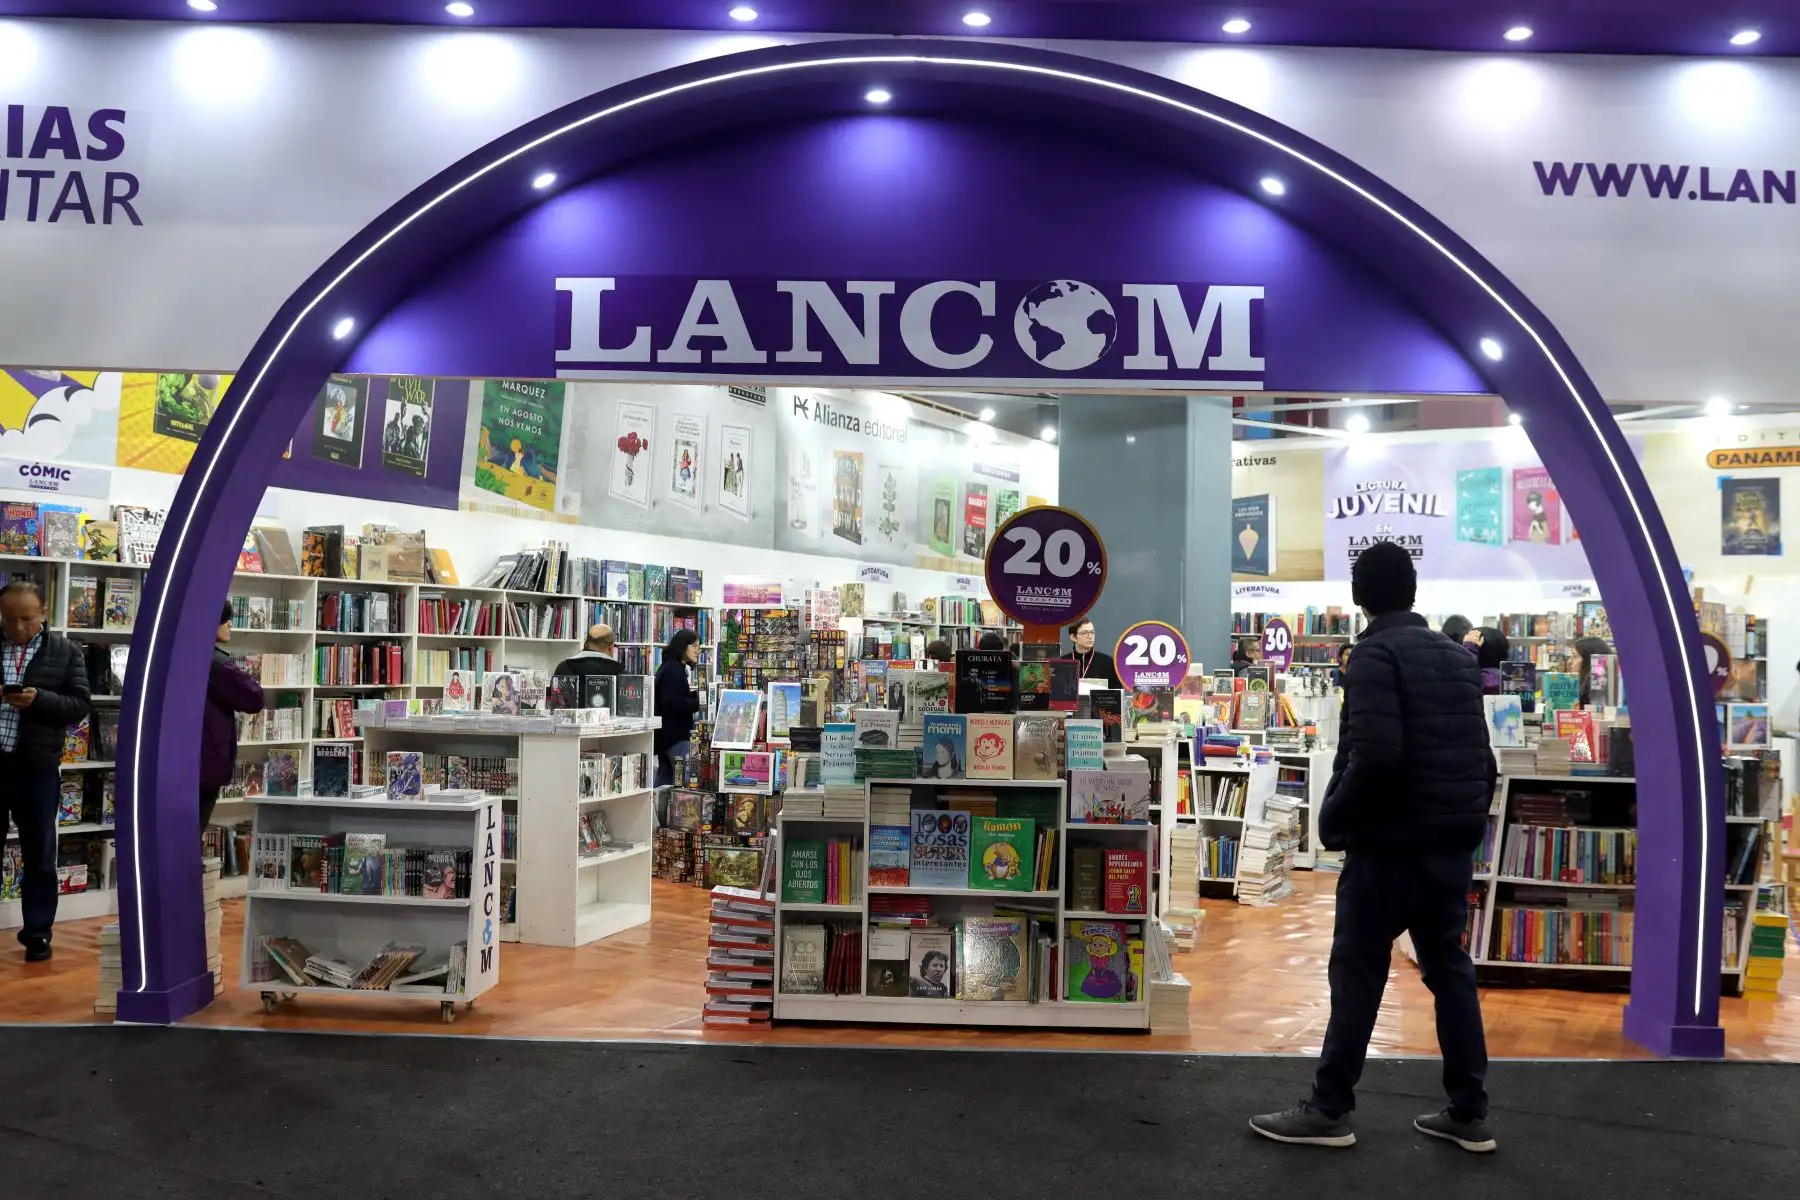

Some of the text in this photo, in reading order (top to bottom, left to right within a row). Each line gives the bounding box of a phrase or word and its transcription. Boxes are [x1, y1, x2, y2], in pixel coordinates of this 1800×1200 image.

[0, 104, 126, 162] IAS
[1532, 161, 1796, 204] WWW.LAN
[406, 389, 426, 404] WAR
[500, 404, 543, 422] EN AGOSTO
[498, 417, 542, 435] NOS VEMOS
[814, 401, 907, 444] Alianza editorial
[19, 462, 71, 481] CÓMIC
[1354, 480, 1407, 493] LECTURA
[1326, 492, 1449, 519] JUVENIL
[1375, 524, 1392, 535] EN
[1003, 526, 1101, 577] 20%
[1235, 586, 1280, 595] LITERATURA
[1124, 634, 1187, 666] 20%
[927, 725, 961, 735] mami
[914, 813, 968, 834] 1000
[914, 833, 968, 847] cosas
[792, 850, 818, 859] AMARSE
[913, 846, 967, 860] SUPER
[791, 860, 818, 869] CON LOS
[913, 860, 967, 868] interesantes
[795, 870, 812, 879] OJOS
[787, 879, 818, 889] ABIERTOS
